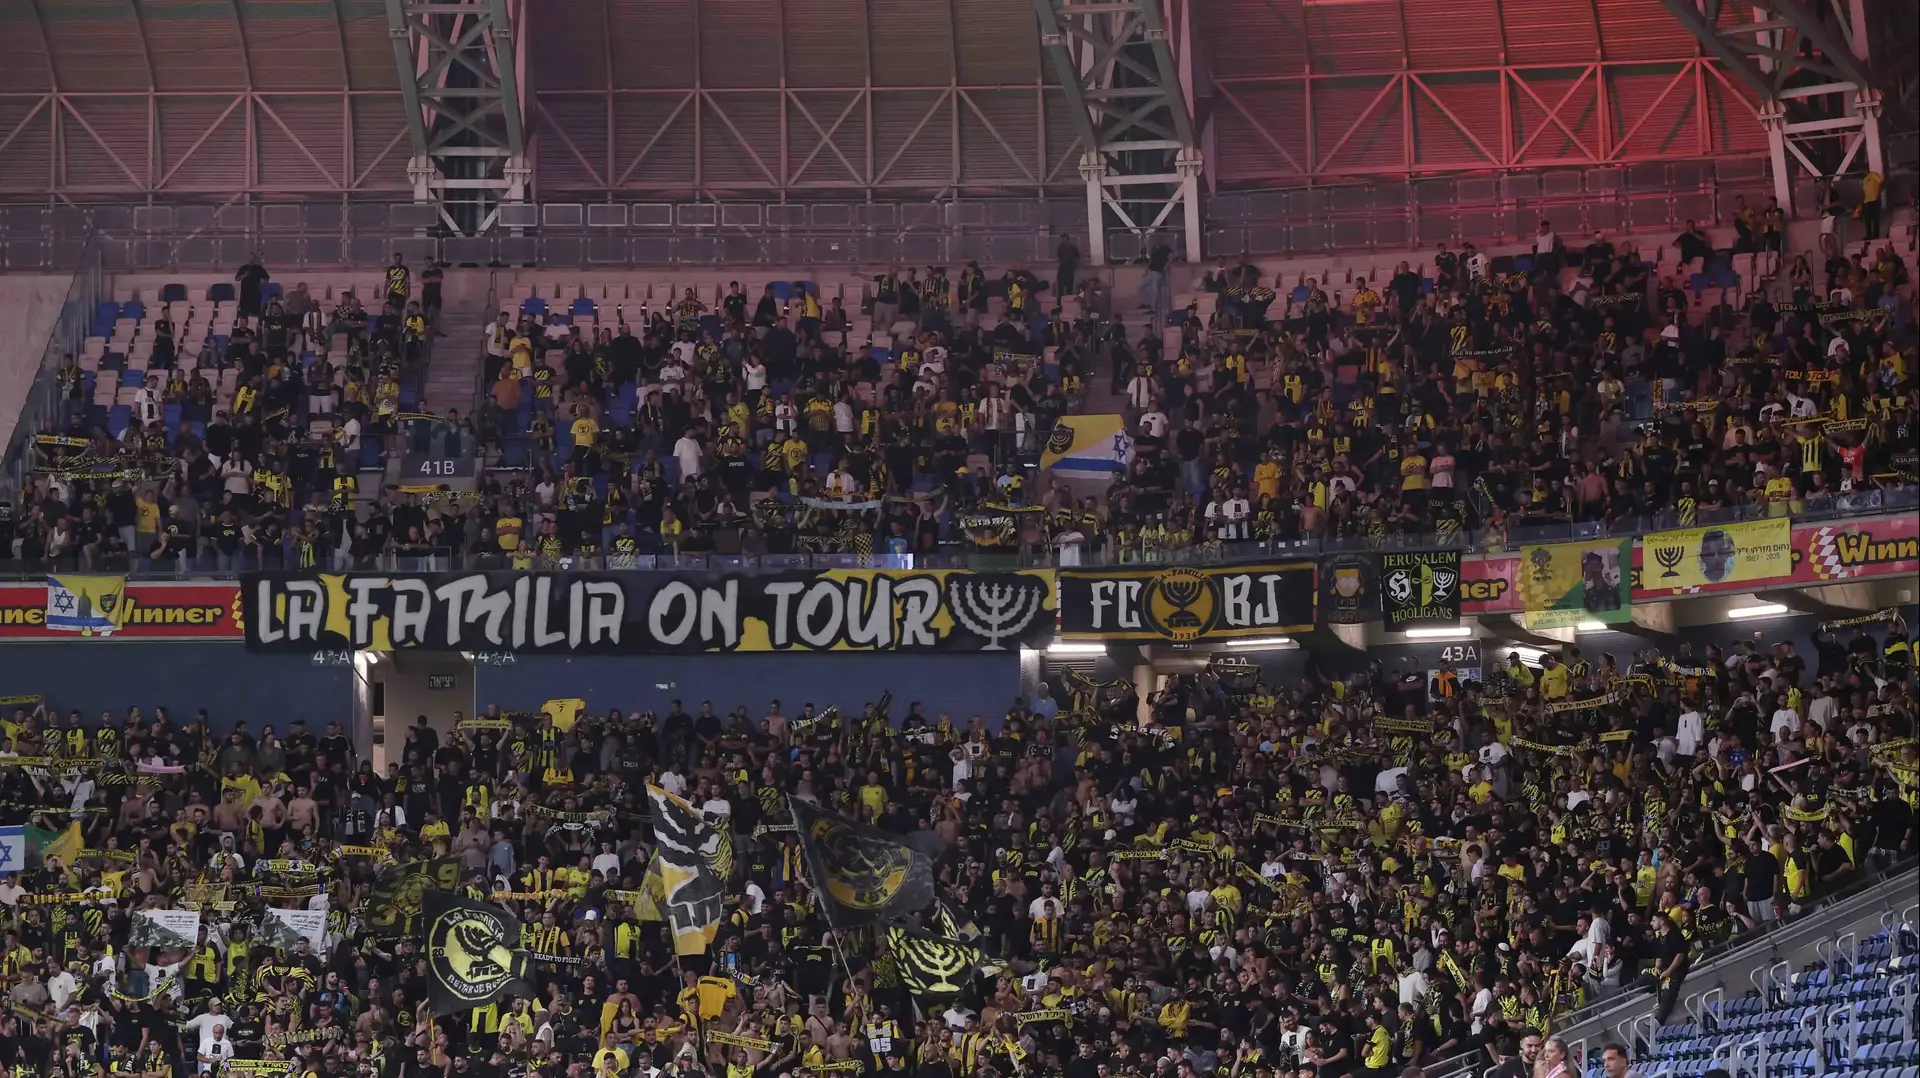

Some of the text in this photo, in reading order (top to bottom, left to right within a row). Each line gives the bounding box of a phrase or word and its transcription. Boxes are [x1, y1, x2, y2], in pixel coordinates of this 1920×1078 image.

[1785, 370, 1802, 380] FCBJ
[420, 461, 455, 475] 41B
[1773, 543, 1789, 551] נחום
[1383, 552, 1456, 568] JERUSALEM
[1766, 552, 1781, 560] 2025
[1090, 574, 1283, 629] FC BJ
[258, 573, 941, 649] LA FAMILIA ON TOUR
[1391, 608, 1453, 624] HOOLIGANS
[1173, 632, 1198, 640] 1936
[1441, 646, 1477, 662] 43A
[429, 676, 454, 688] יציאה
[559, 705, 564, 713] 7
[531, 806, 588, 821] EAST SIDE
[444, 912, 464, 926] LA
[534, 952, 554, 961] READY
[870, 1037, 892, 1053] 05
